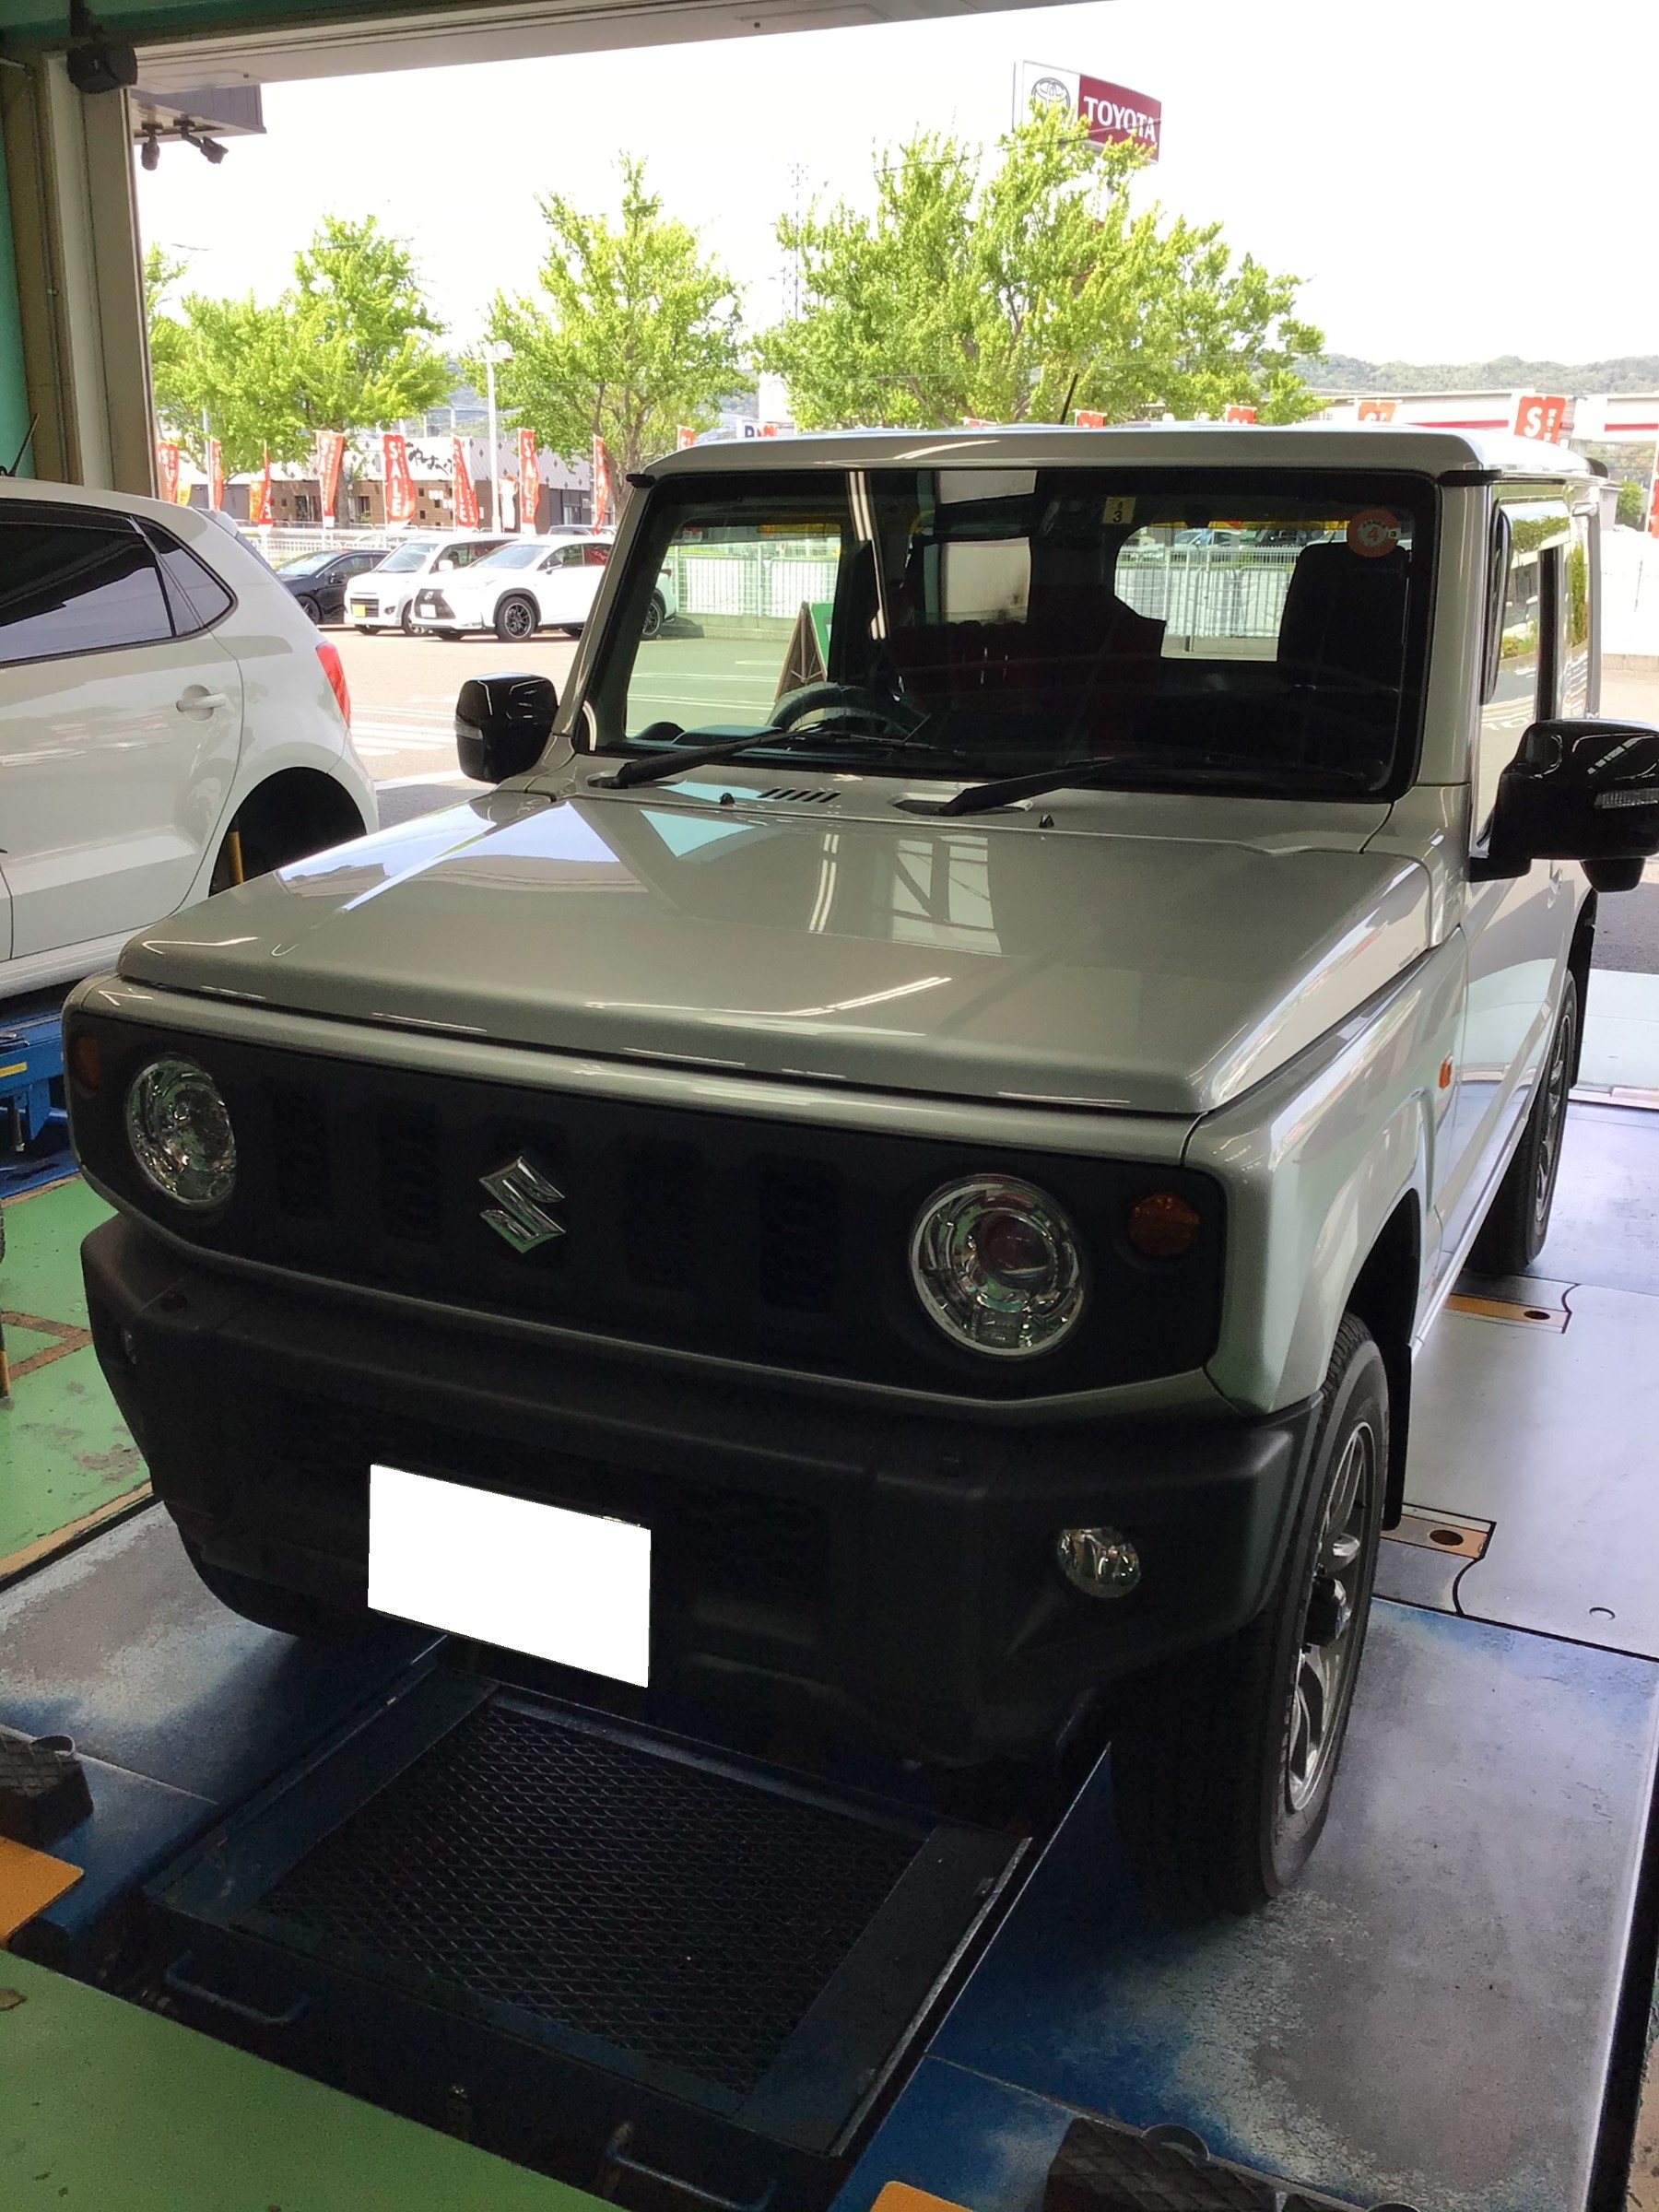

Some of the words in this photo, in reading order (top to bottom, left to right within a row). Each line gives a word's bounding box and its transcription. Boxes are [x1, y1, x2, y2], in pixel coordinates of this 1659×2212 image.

[1083, 95, 1157, 142] TOYOTA
[389, 441, 403, 517] SALE
[1112, 510, 1123, 523] 3
